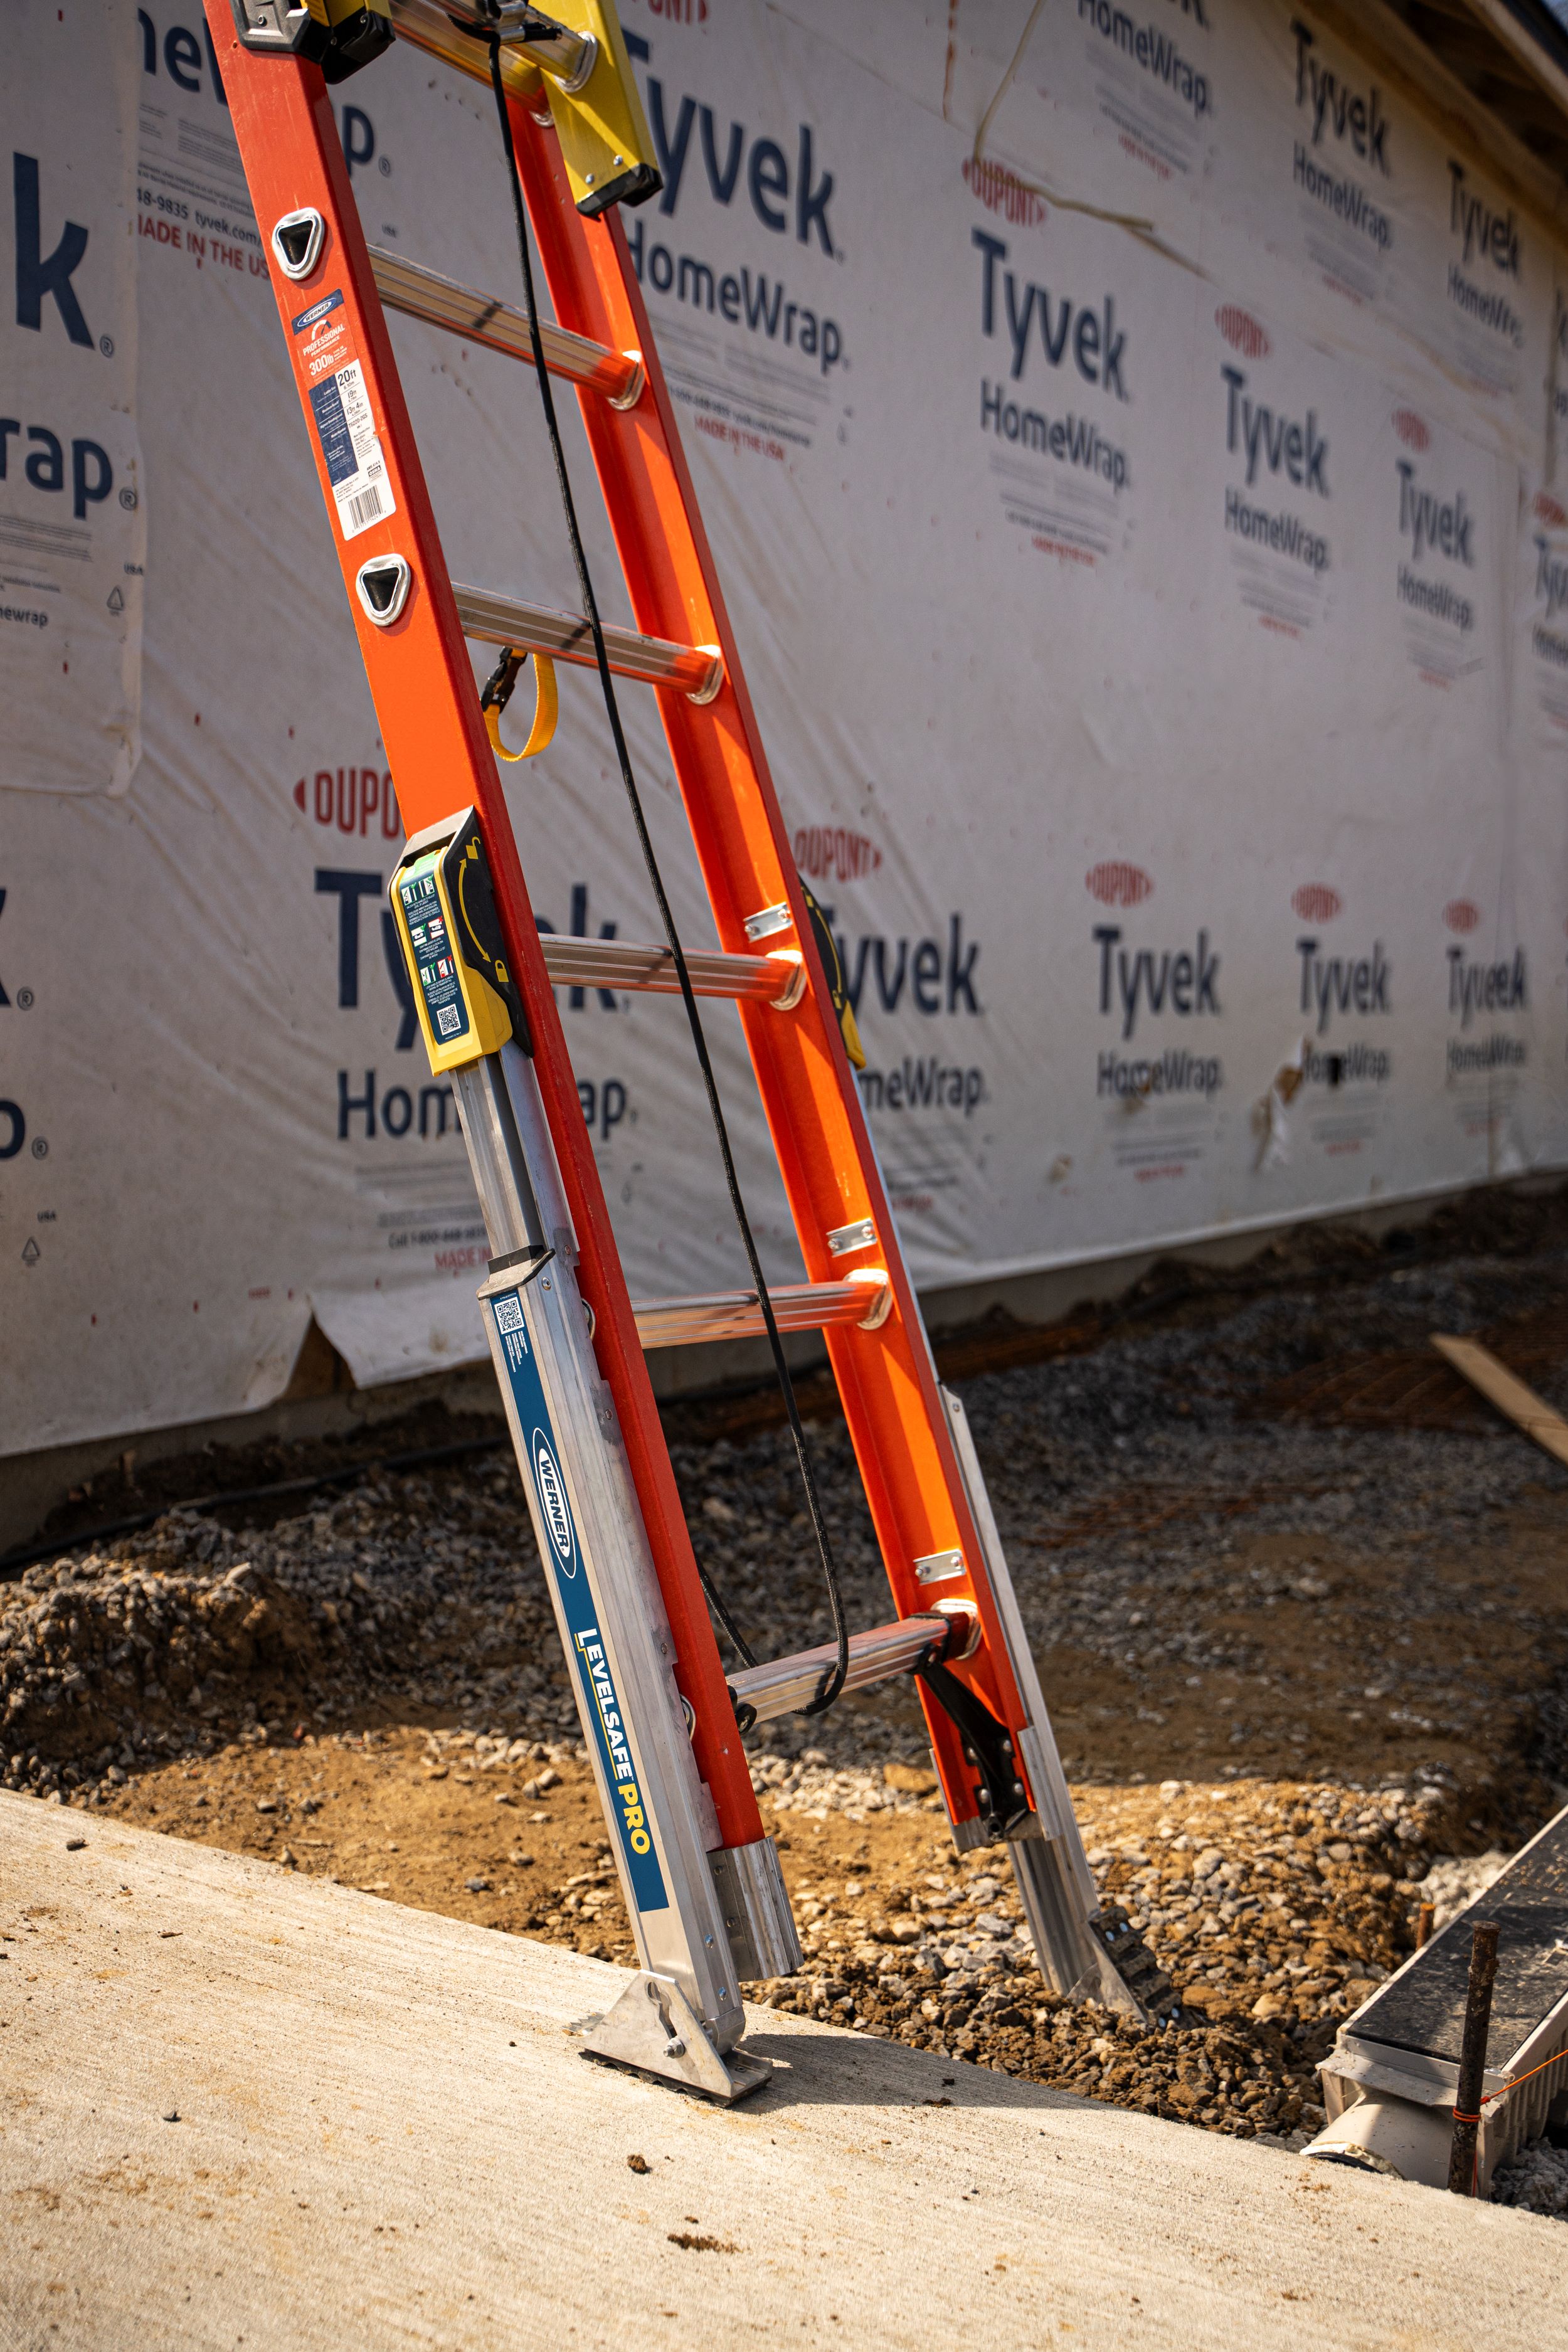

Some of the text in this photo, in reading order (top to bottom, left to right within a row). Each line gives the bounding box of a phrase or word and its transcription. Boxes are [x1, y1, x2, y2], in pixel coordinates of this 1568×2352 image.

[1291, 20, 1389, 177] Tyvek
[620, 26, 835, 260] yvek
[195, 209, 262, 246] tyvek.com/
[1293, 139, 1391, 250] HomeWrap
[187, 232, 206, 258] IN
[209, 240, 244, 272] THE
[248, 253, 270, 280] US
[303, 323, 346, 357] PROFESSIONAL
[305, 302, 329, 322] WERNER
[310, 335, 341, 358] PERFORMANCE
[971, 225, 1128, 403] Tyvek
[309, 354, 334, 376] 300lb
[337, 369, 356, 386] 20ft
[347, 389, 357, 399] 19ft
[346, 406, 356, 415] 13ft
[980, 376, 1128, 500] HomeWrap
[1221, 359, 1330, 500] Tyvek
[1224, 484, 1330, 577] HomeWrap
[1395, 458, 1474, 568] Tyvek
[1397, 562, 1474, 637] HomeWrap
[314, 766, 403, 840] DUPO
[314, 867, 622, 1052] Tyk
[1093, 924, 1218, 1042] Tyvek
[1295, 936, 1391, 1037] Tyvek
[336, 1068, 627, 1142] Homap
[862, 1057, 983, 1118] meWrap
[1096, 1049, 1219, 1102] HomeWrap
[434, 1247, 475, 1271] MADE
[540, 1458, 569, 1551] WERNER
[576, 1628, 650, 1855] LEVELSAFE PRO
